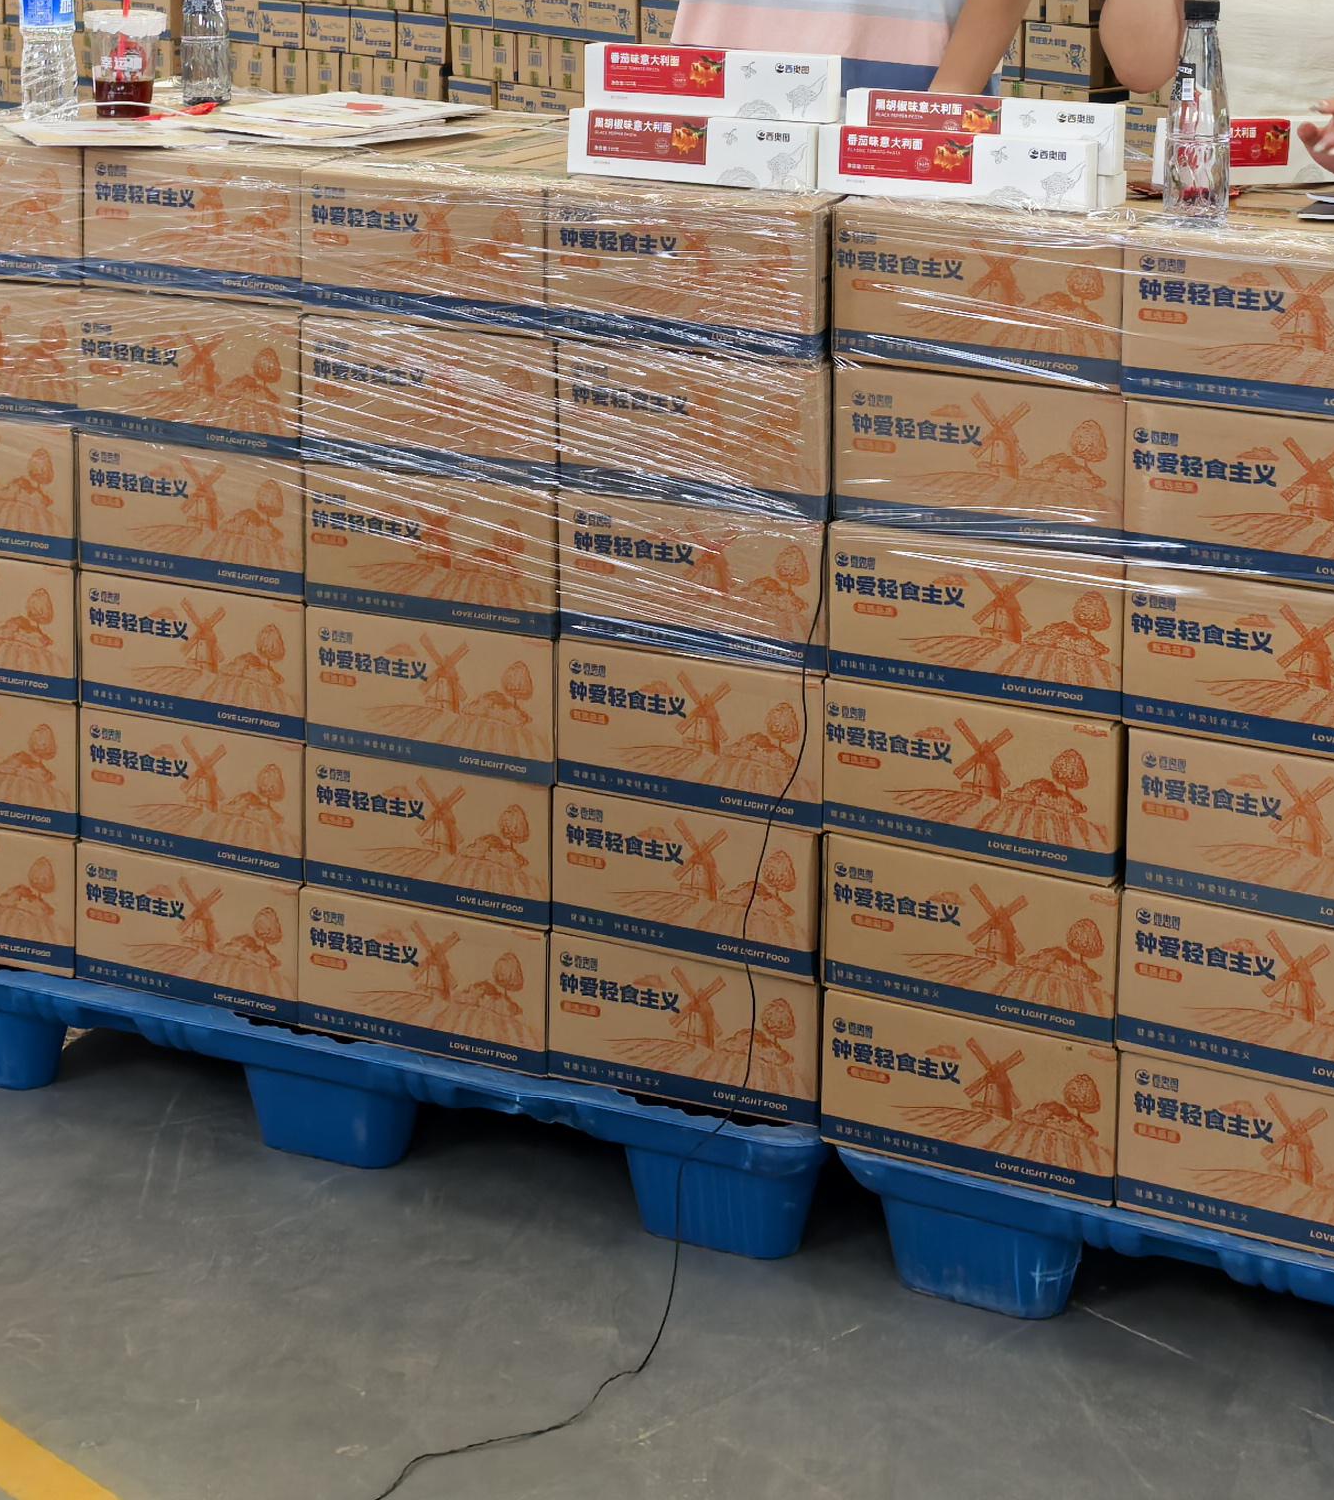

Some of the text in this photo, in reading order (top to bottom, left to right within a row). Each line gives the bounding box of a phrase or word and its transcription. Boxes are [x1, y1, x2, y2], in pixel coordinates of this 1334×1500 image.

[610, 51, 680, 67] 番茄味意大利面
[874, 98, 963, 116] 黑胡椒味意大利面
[594, 116, 673, 134] 黑胡椒味意大利面
[846, 132, 924, 152] 番茄味意大利面
[96, 183, 193, 208] 钟爱轻食主义
[837, 249, 962, 279] 钟爱轻食主义
[1140, 279, 1285, 313] 钟爱轻食主义
[81, 342, 177, 366] 钟爱轻食主义
[853, 414, 979, 445] 钟爱轻食主义
[89, 469, 187, 498] 钟爱轻食主义
[1133, 452, 1276, 487] 钟爱轻食主义
[574, 531, 693, 565] 钟爱轻食主义
[836, 573, 964, 608] 钟爱轻食主义
[89, 608, 188, 639] 钟爱轻食主义
[1131, 614, 1273, 653] 钟爱轻食主义
[320, 649, 426, 679] 钟爱轻食主义
[570, 681, 684, 716] 钟爱轻食主义
[1002, 683, 1084, 701] LOVE LIGHT FOOD
[827, 724, 951, 761] 钟爱轻食主义
[89, 745, 188, 777] 钟爱轻食主义
[317, 787, 423, 818] 钟爱轻食主义
[1143, 777, 1279, 819] 钟爱轻食主义
[567, 825, 681, 863] 钟爱轻食主义
[86, 883, 184, 919] 钟爱轻食主义
[834, 885, 958, 924] 钟爱轻食主义
[311, 929, 417, 965] 钟爱轻食主义
[1136, 931, 1274, 978] 钟爱轻食主义
[560, 975, 678, 1012] 钟爱轻食主义
[995, 1004, 1076, 1026] LOVE LIGHT FOOD
[834, 1039, 958, 1081] 钟爱轻食主义
[1135, 1094, 1272, 1142] 钟爱轻食主义
